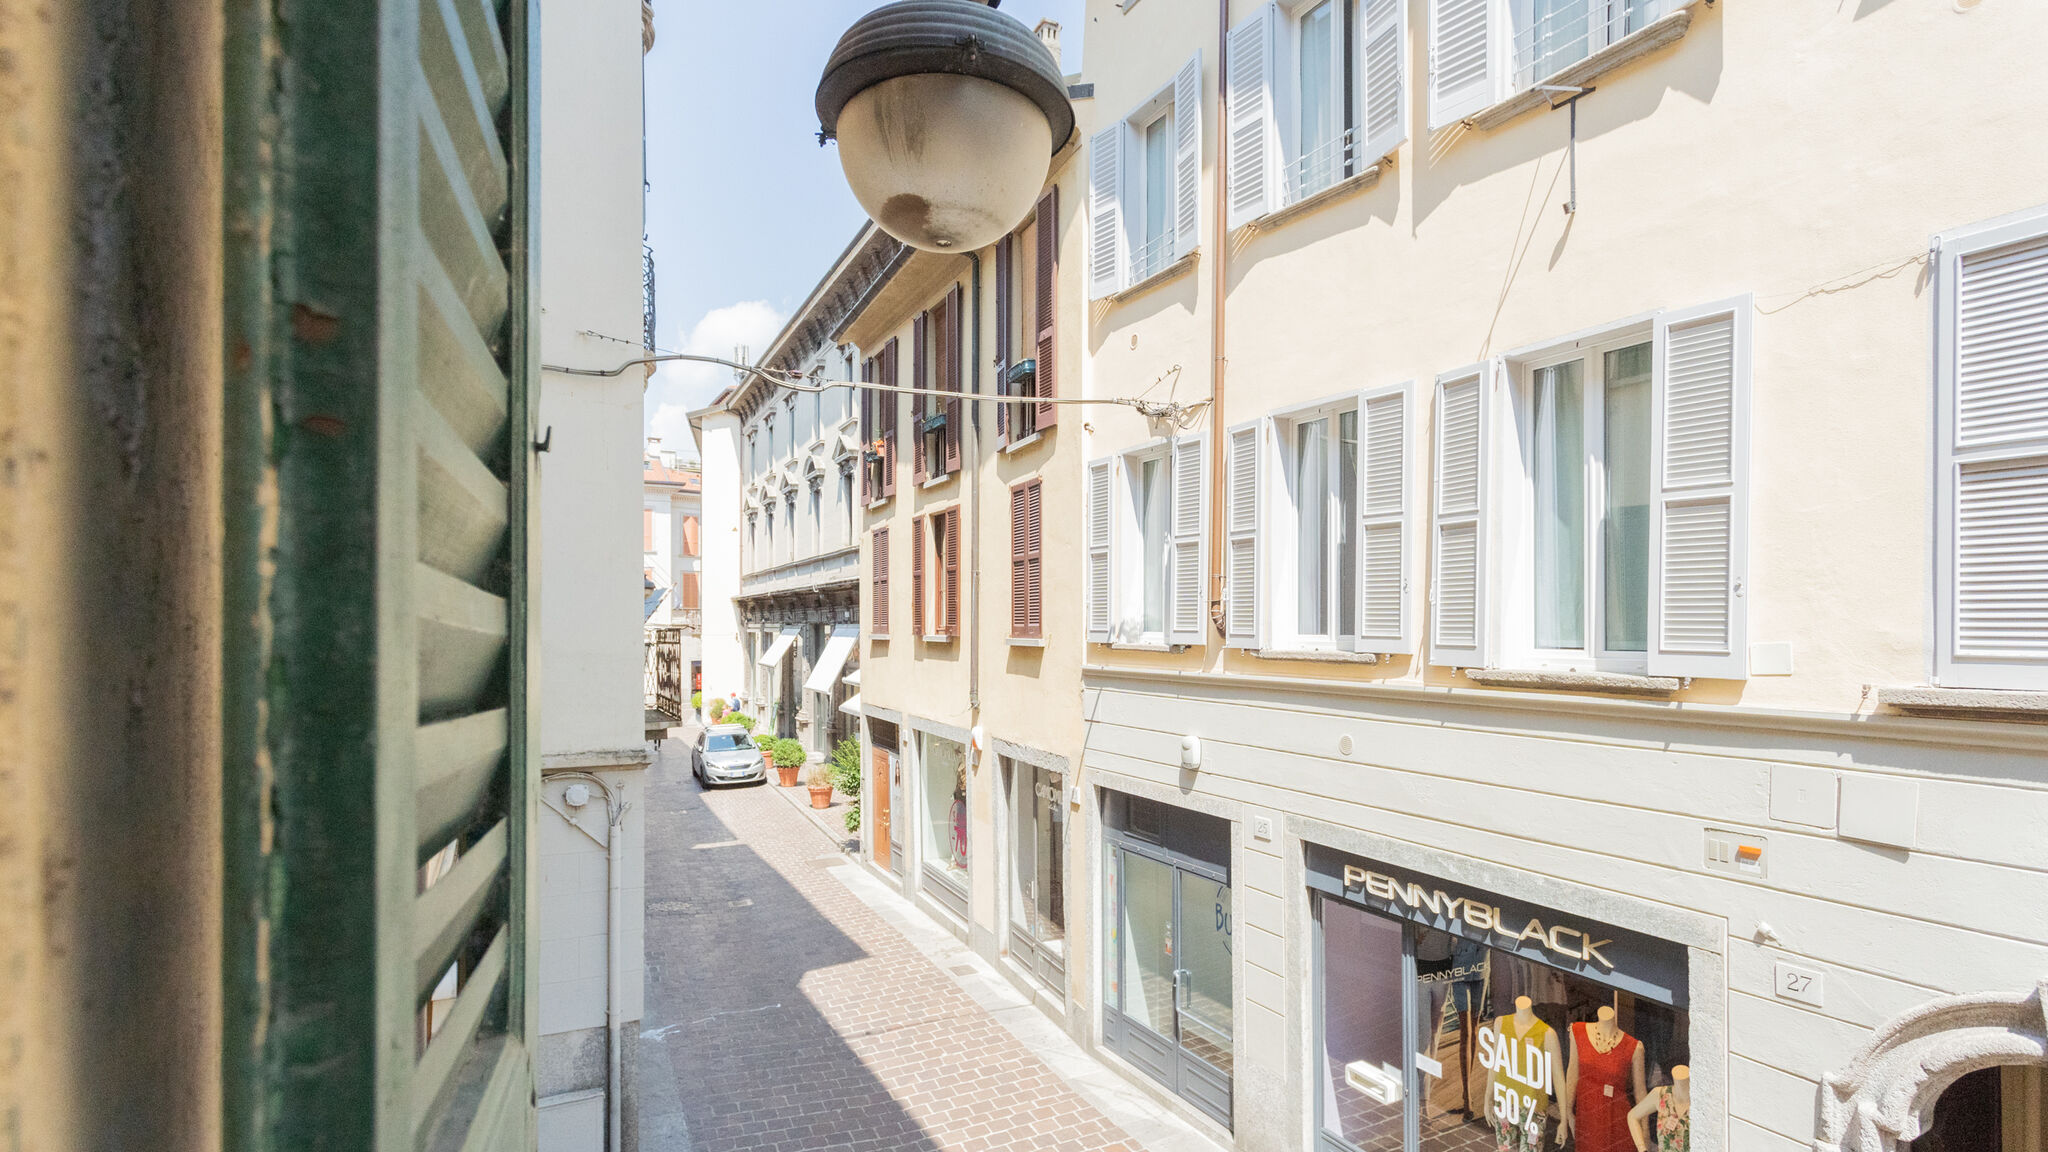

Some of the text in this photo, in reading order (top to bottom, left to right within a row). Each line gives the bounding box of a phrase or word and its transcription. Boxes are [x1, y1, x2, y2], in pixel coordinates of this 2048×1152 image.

[1344, 864, 1614, 969] PENNYBLACK
[1786, 972, 1812, 992] 27
[1478, 1026, 1552, 1096] SALDI
